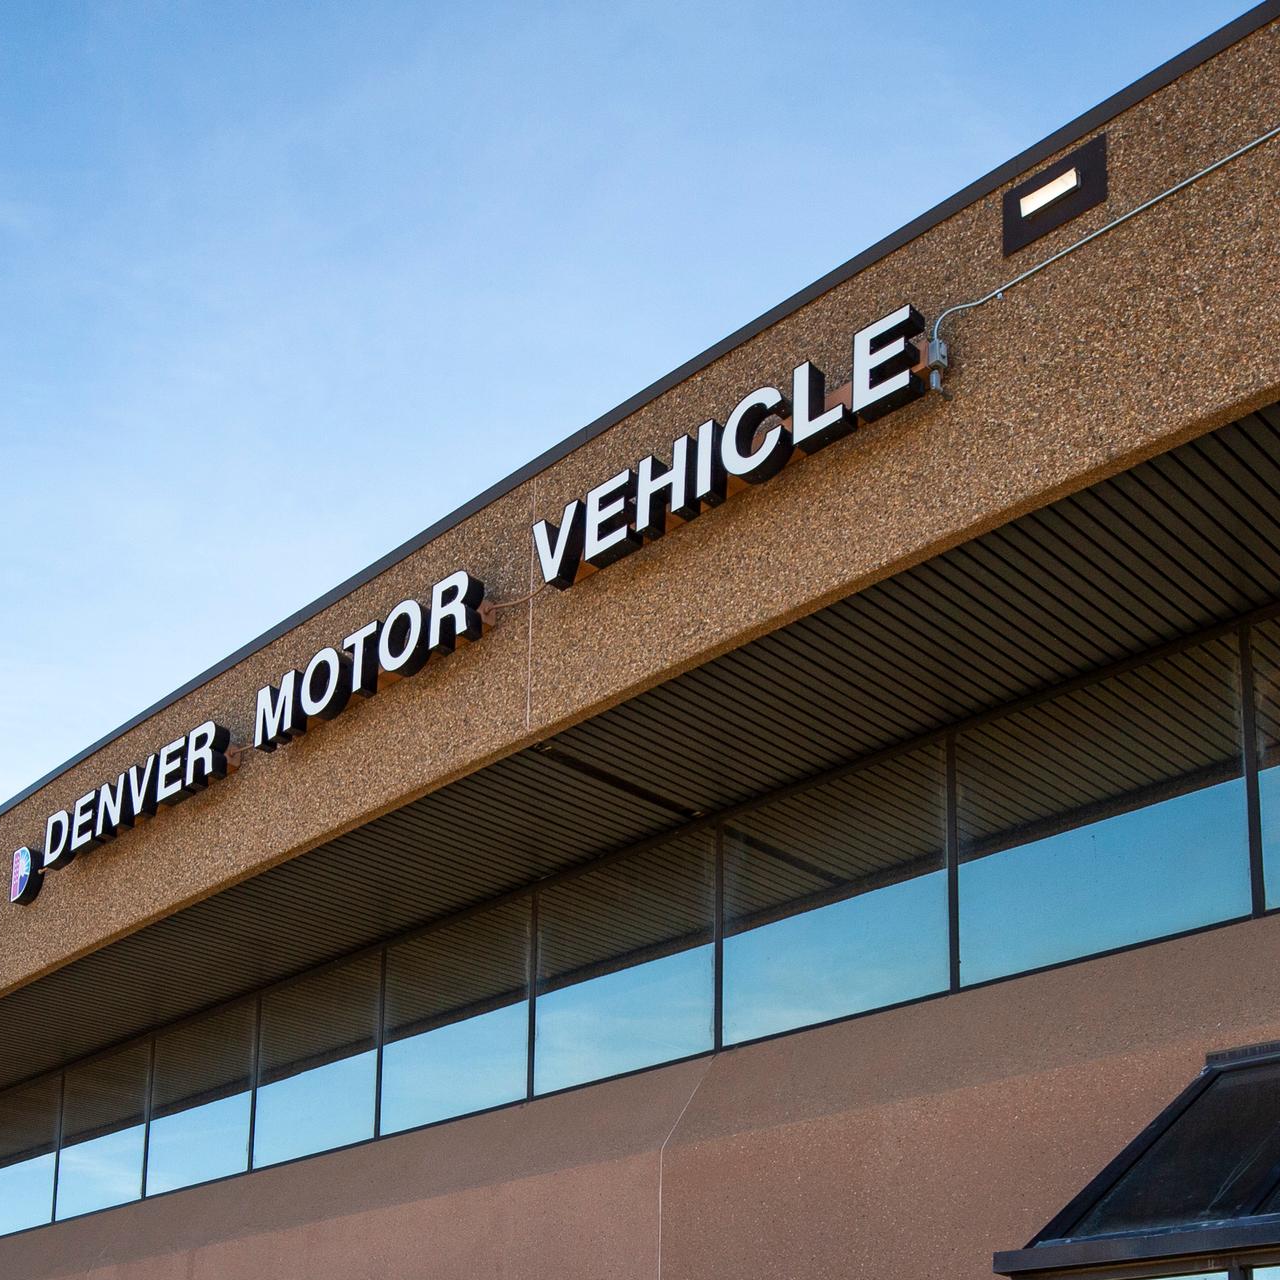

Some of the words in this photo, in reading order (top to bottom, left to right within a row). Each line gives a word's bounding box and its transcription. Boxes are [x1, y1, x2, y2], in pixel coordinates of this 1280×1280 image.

[43, 720, 217, 867] DENVER
[253, 570, 470, 749] MOTOR
[532, 303, 912, 584] VEHICLE
